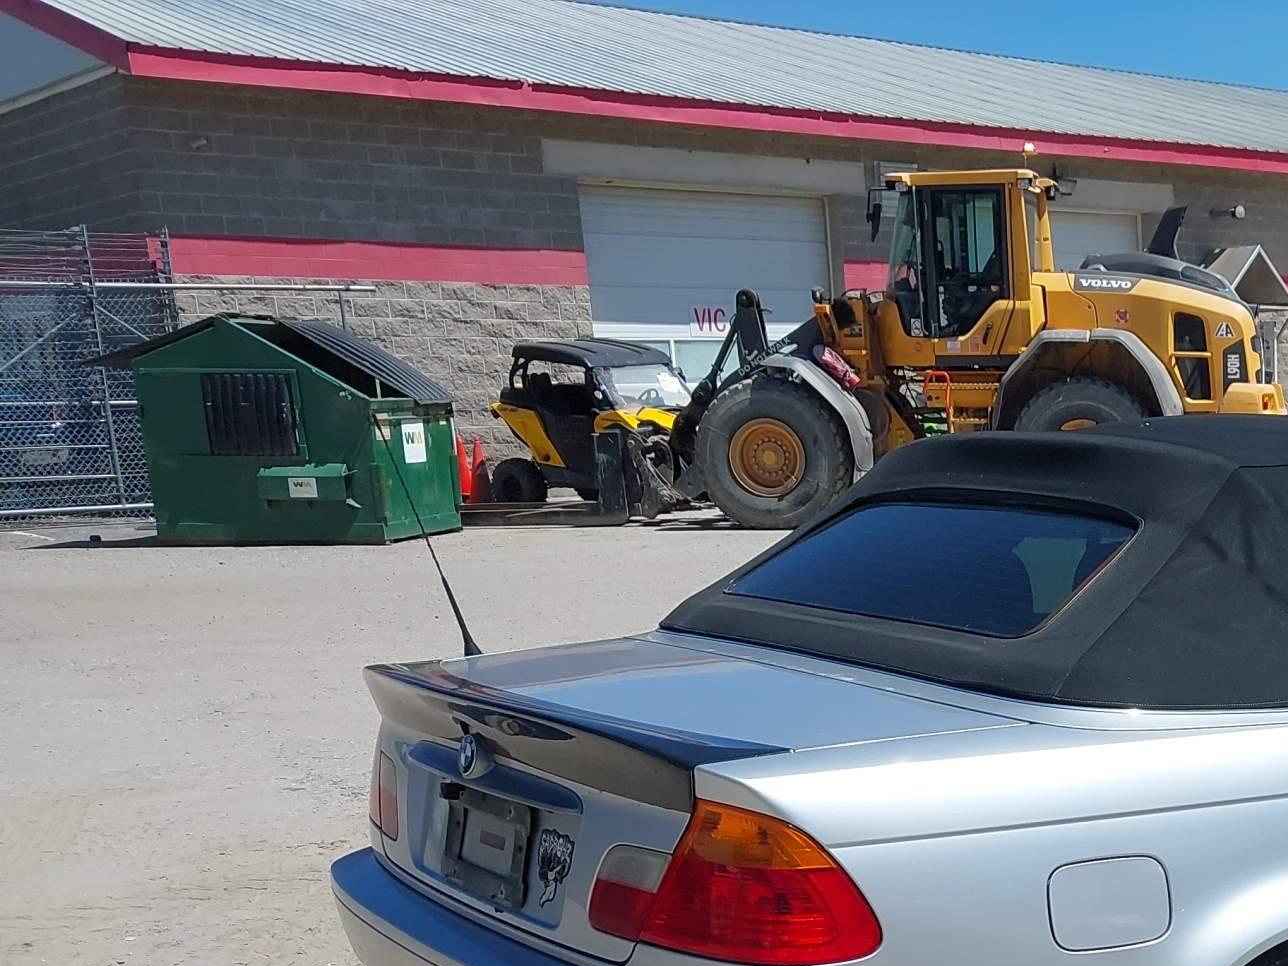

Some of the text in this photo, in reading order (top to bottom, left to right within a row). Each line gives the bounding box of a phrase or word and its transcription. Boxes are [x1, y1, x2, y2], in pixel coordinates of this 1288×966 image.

[1080, 279, 1132, 288] VOLVO
[693, 307, 727, 333] VIC
[1226, 354, 1241, 379] L90H
[404, 431, 423, 445] WM
